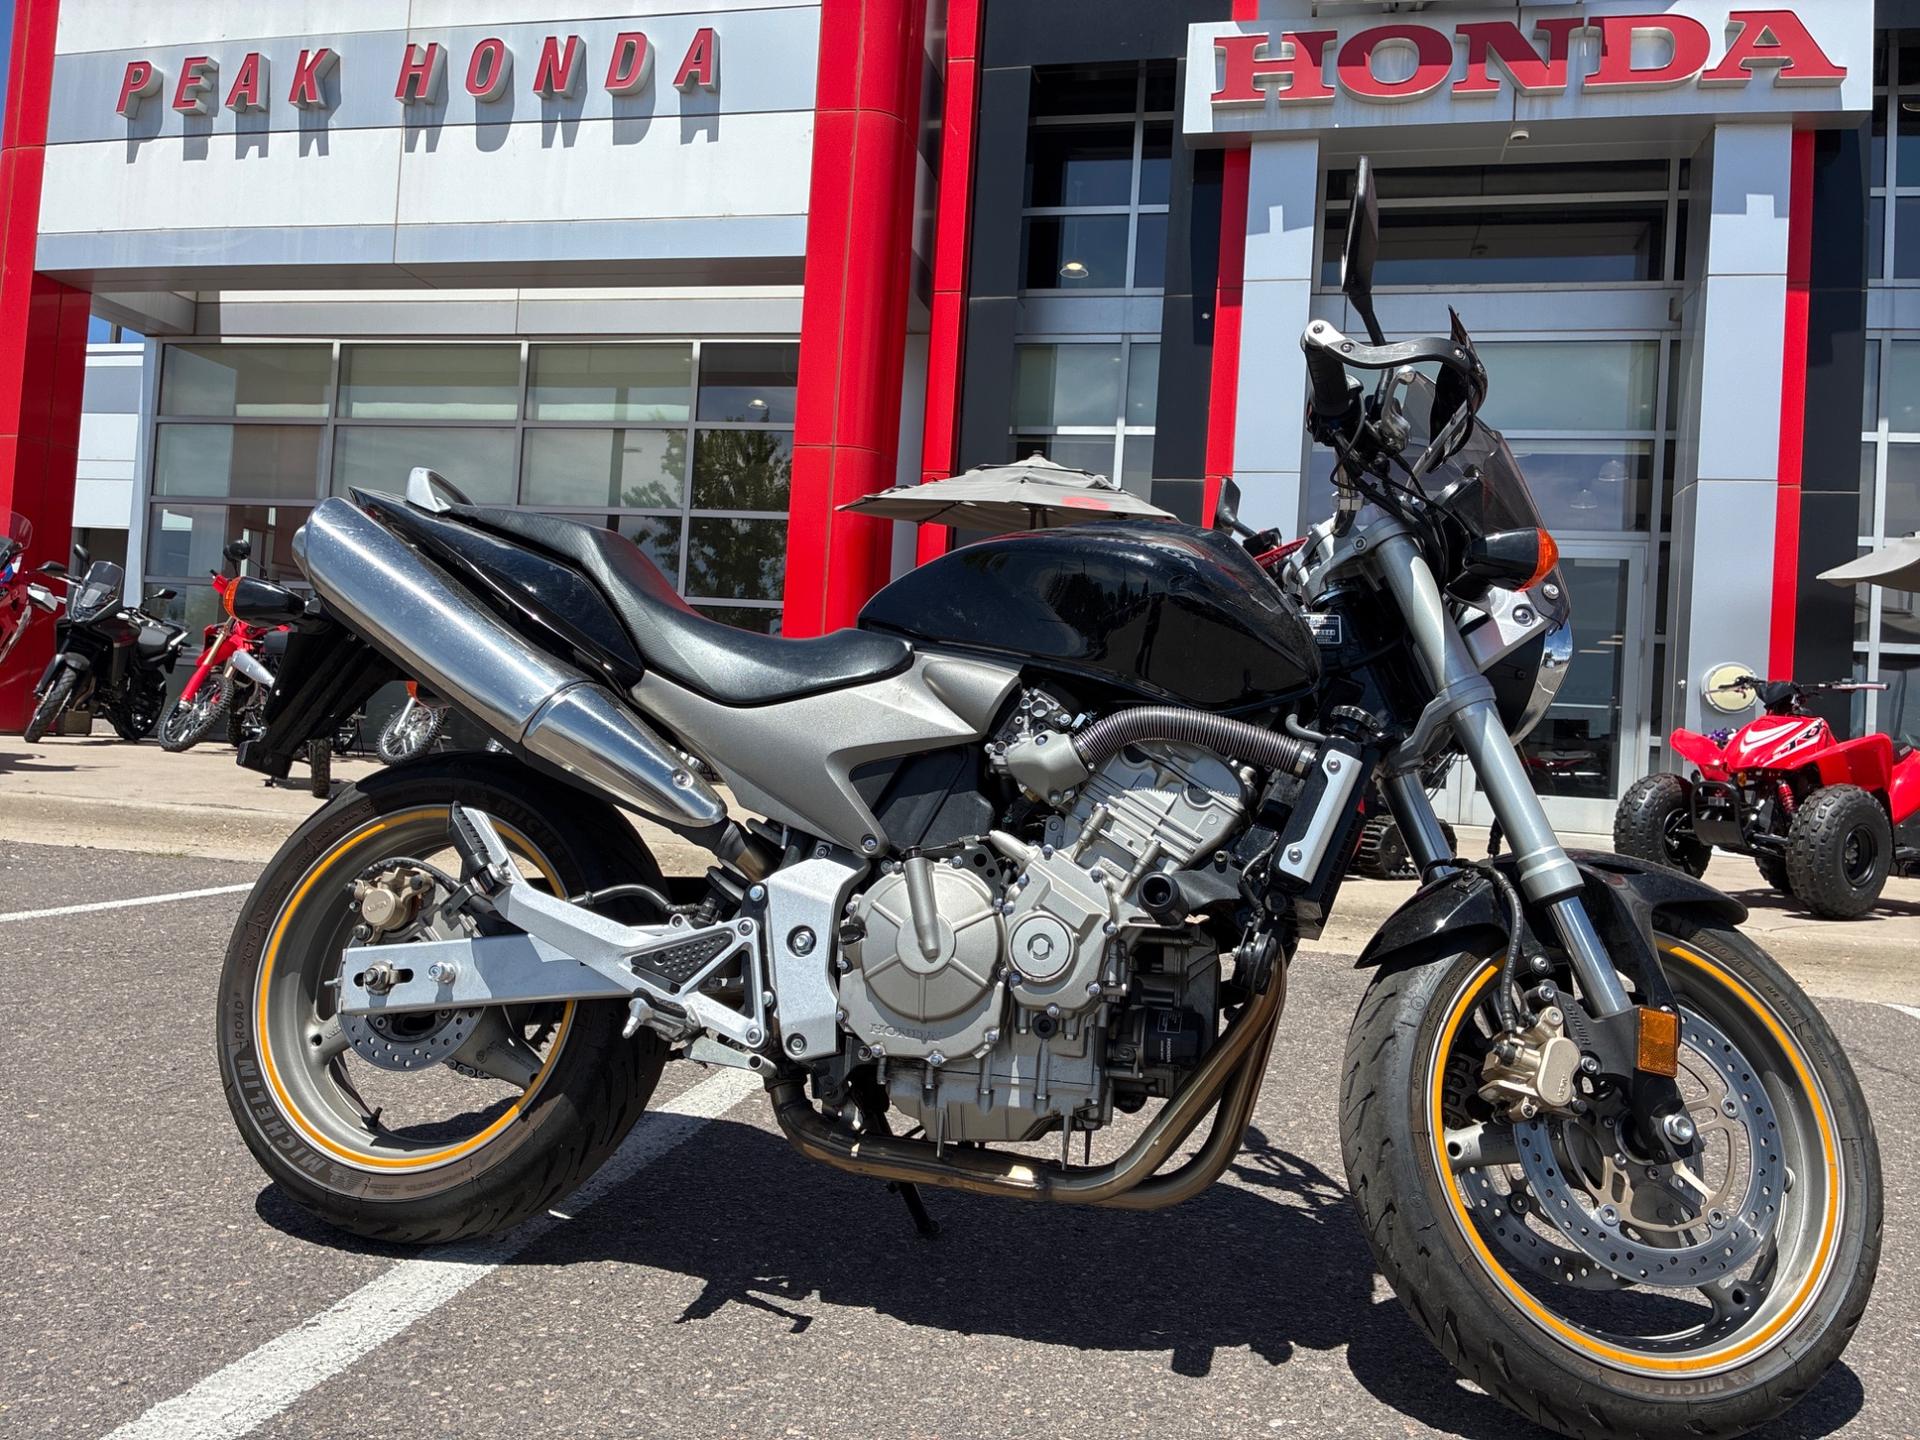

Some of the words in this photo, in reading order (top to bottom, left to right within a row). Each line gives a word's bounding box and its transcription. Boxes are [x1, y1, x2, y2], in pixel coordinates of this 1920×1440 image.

[116, 48, 339, 118] PEAK
[395, 27, 721, 104] HONDA
[1211, 10, 1848, 108] HONDA
[234, 1000, 245, 1040] ROAD
[237, 1058, 326, 1174] MICHELIN
[1610, 1376, 1726, 1397] MICHELIN
